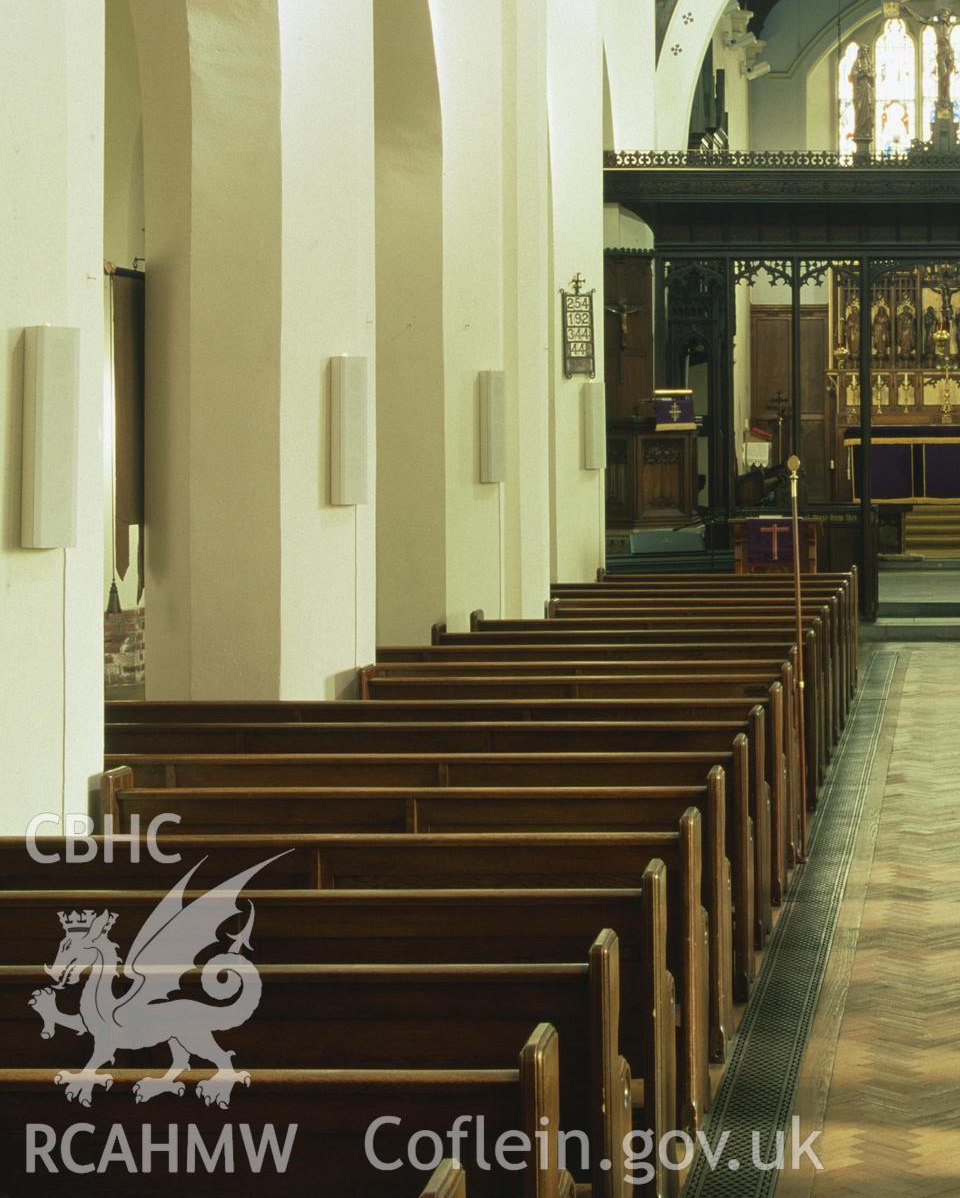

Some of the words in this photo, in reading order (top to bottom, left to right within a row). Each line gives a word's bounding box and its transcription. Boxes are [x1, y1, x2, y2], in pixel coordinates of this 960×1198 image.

[567, 298, 589, 309] 254
[568, 313, 589, 324] 192
[567, 329, 590, 339] 344
[570, 343, 587, 355] 44
